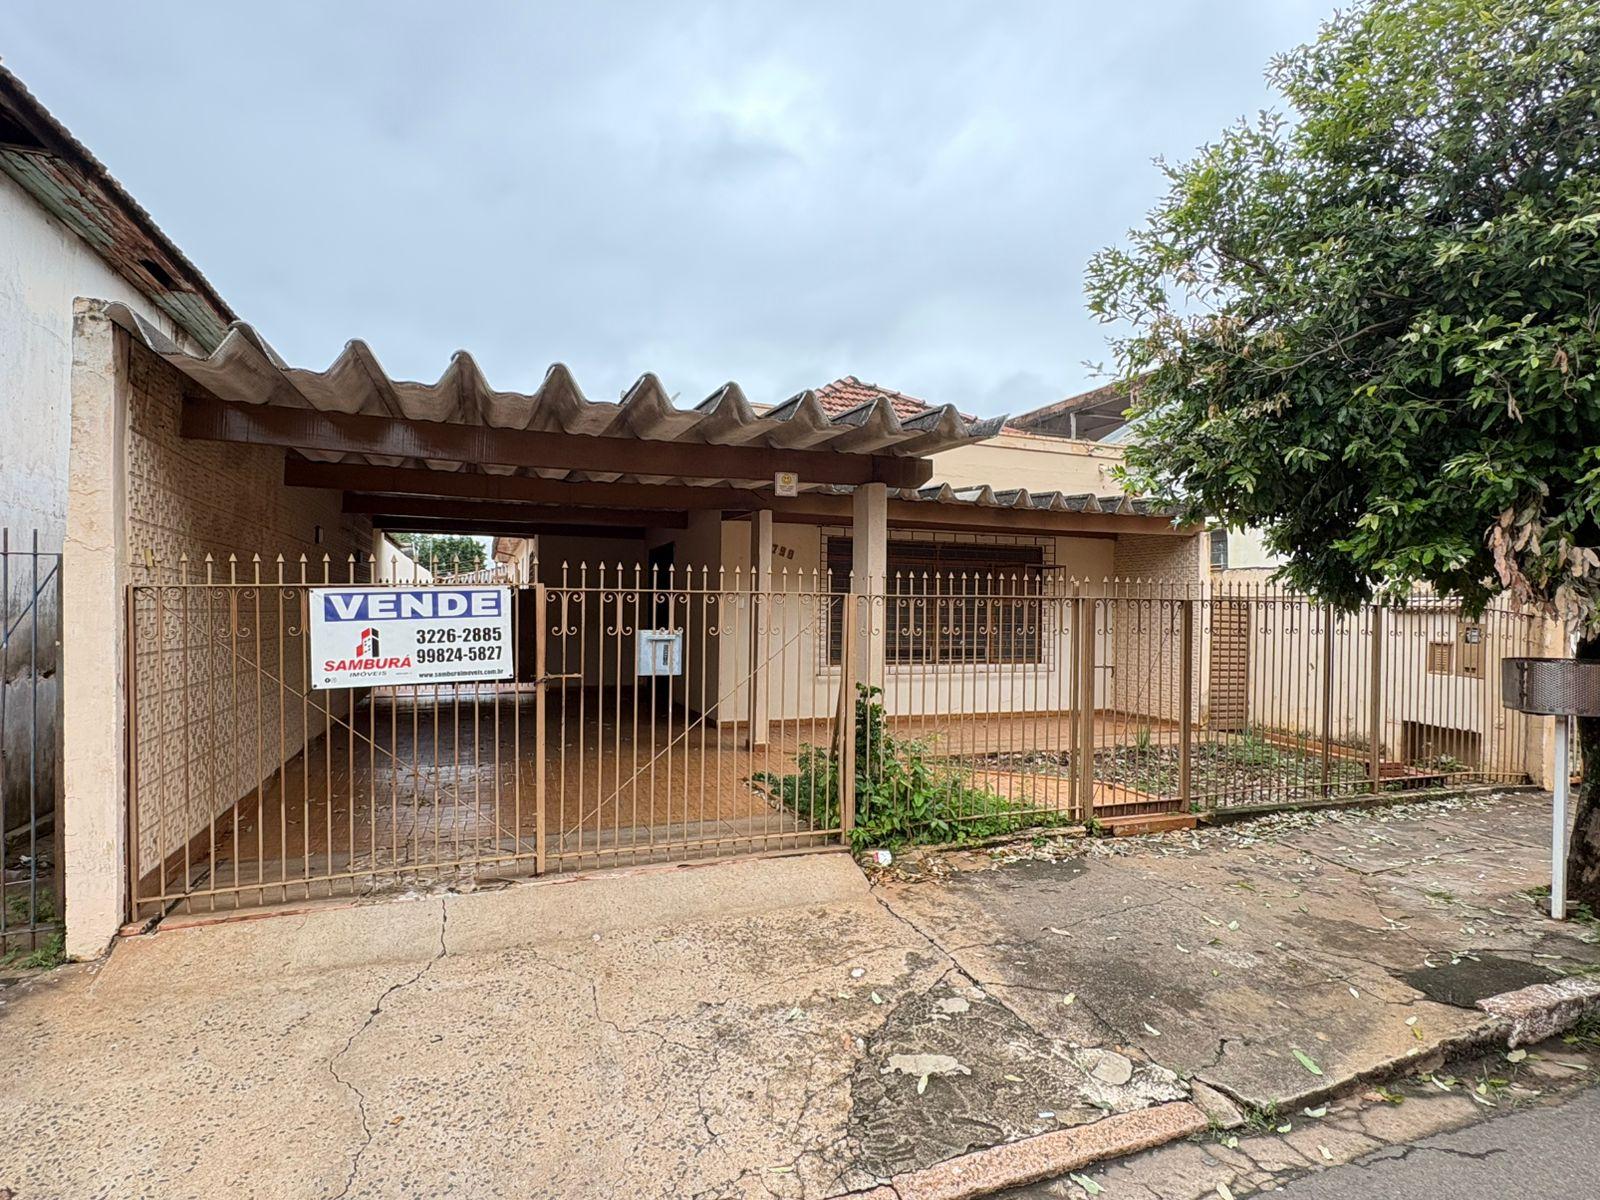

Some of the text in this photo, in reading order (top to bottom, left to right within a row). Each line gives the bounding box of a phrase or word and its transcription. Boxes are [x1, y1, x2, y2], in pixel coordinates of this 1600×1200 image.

[328, 591, 499, 619] VENDE
[416, 627, 502, 644] 3226-2885
[323, 654, 412, 672] SAMBURÁ
[416, 646, 502, 663] 99824-5827
[349, 670, 388, 678] IMÓVEIS
